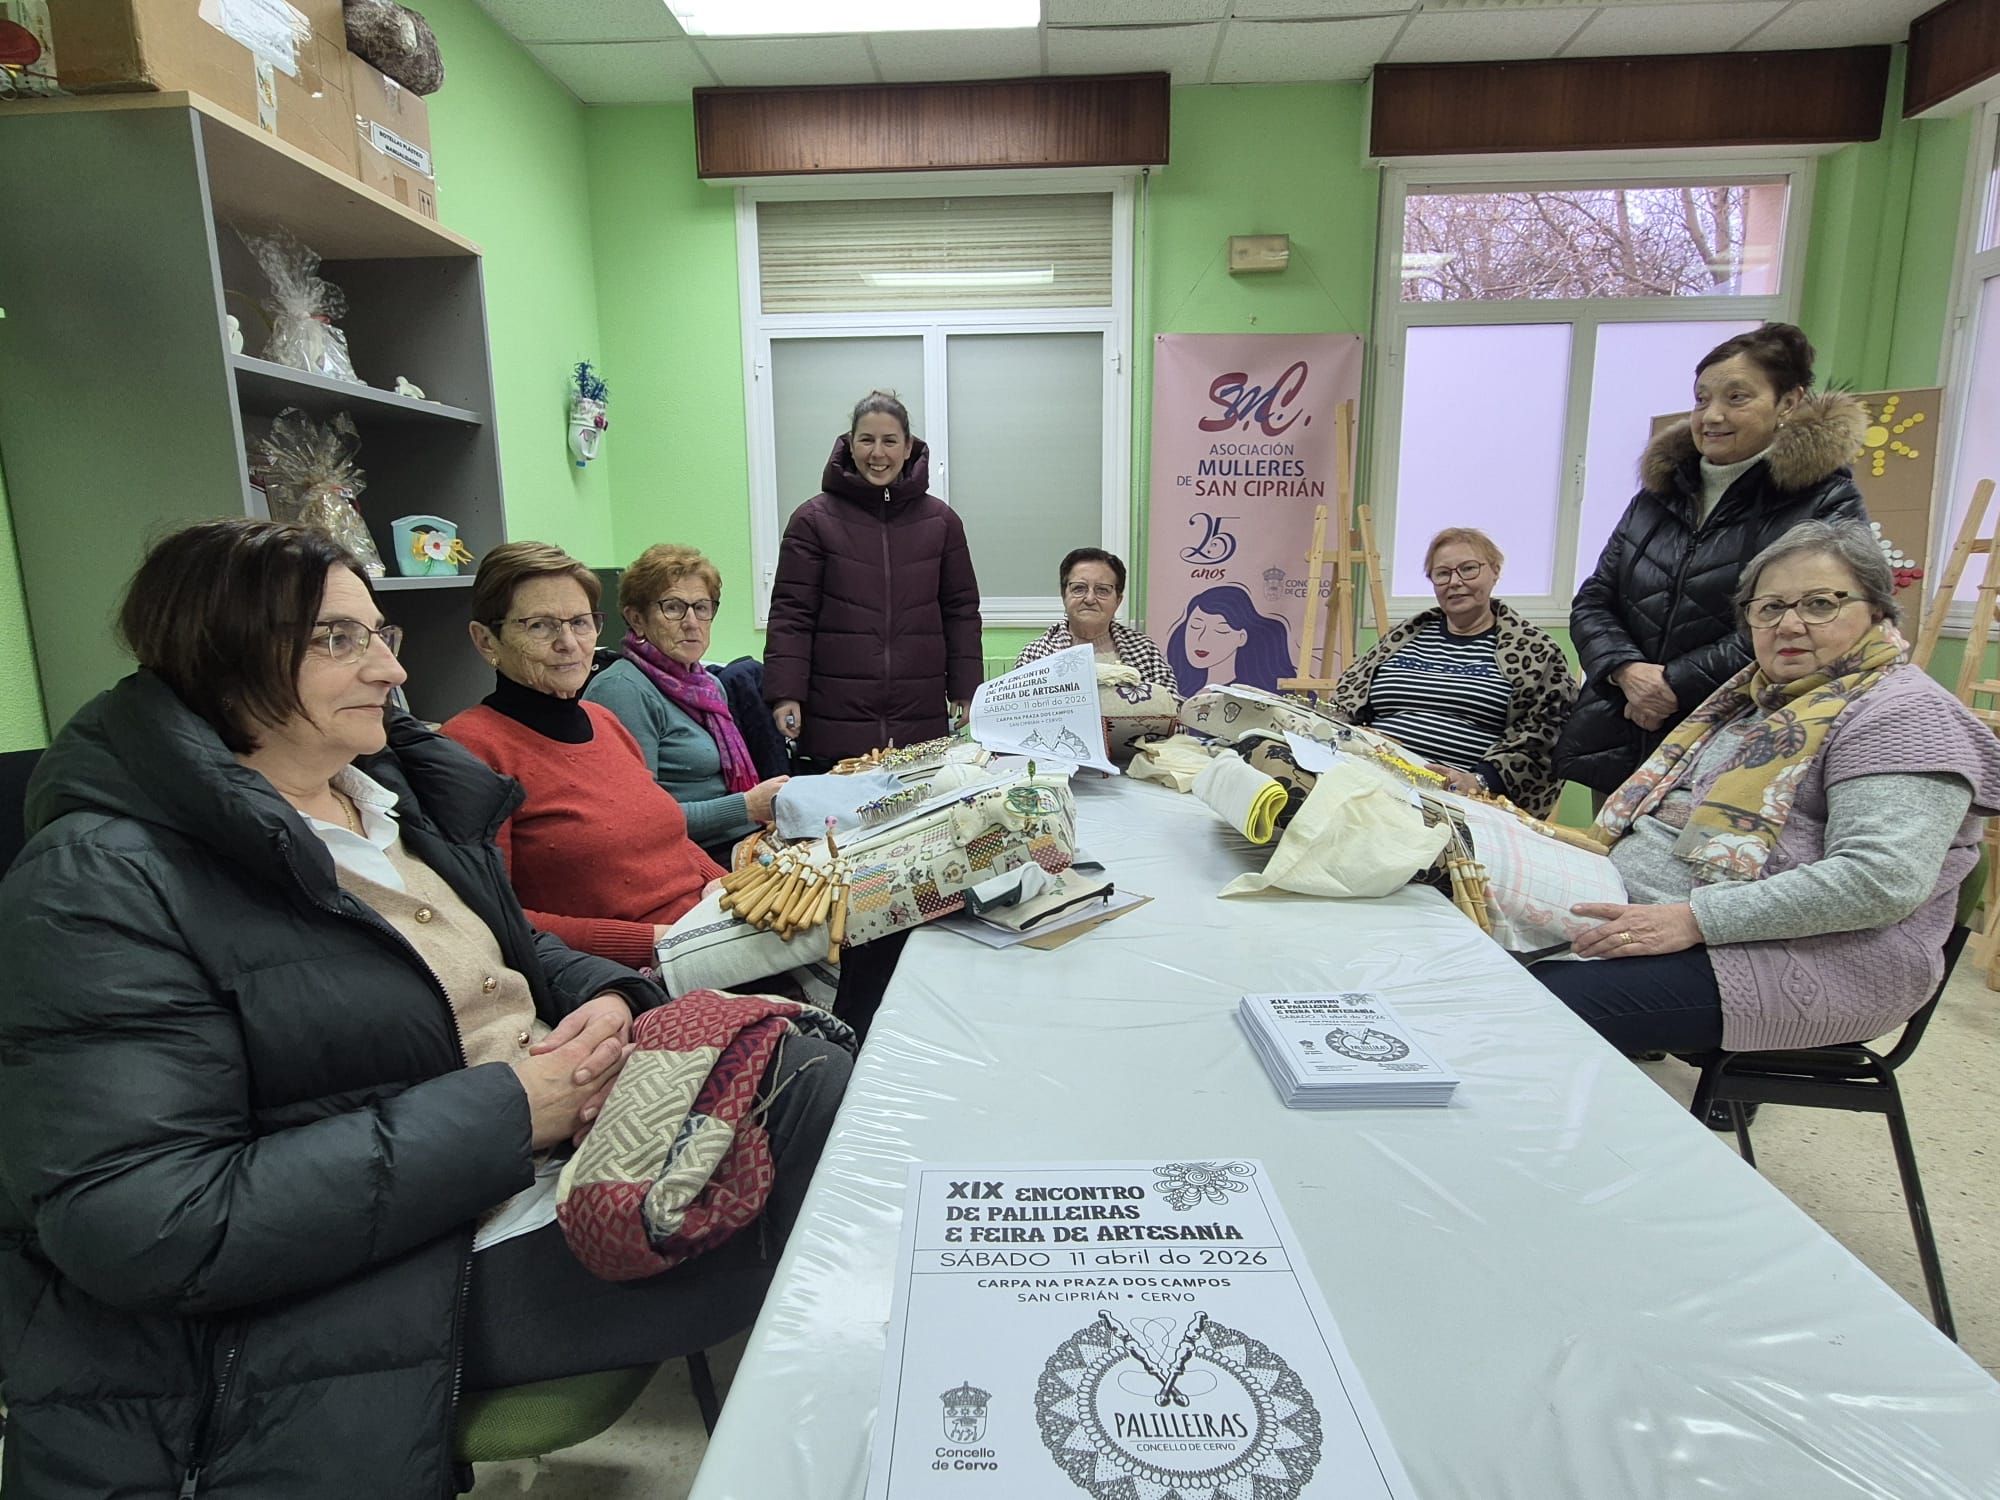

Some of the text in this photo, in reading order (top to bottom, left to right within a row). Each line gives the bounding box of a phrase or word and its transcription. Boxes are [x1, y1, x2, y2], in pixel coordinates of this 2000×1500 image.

[379, 130, 403, 148] BOTELLAS
[1209, 442, 1294, 456] ASOCIACIÓN
[1198, 460, 1305, 477] MULLERES
[1177, 476, 1325, 497] DE SAN CIPRIÁN
[1180, 512, 1241, 565] 25
[1190, 567, 1226, 581] anos
[988, 667, 1050, 690] XIX ENCONTRO
[998, 677, 1048, 694] PALILLEIRAS
[993, 692, 1016, 703] FEIRA
[1018, 689, 1031, 698] DE
[1033, 682, 1080, 696] ARTESANÍA
[1032, 699, 1050, 708] abril
[1052, 698, 1063, 706] do
[1065, 695, 1087, 704] 2026
[1052, 709, 1074, 717] CAMPOS
[946, 1181, 1145, 1201] XIX ENCONTRO
[946, 1205, 1140, 1221] DE PALILLEIRAS
[945, 1222, 1244, 1243] E FEIRA DE ARTESANÍA
[940, 1249, 1268, 1267] SÁBADO 11 abril do 2026
[977, 1277, 1231, 1288] CARPA NA PRAZA DOS CAMPOS
[1017, 1289, 1195, 1302] SAN CIPRIÁN CERVO
[1114, 1412, 1249, 1438] PALILLEIRAS
[935, 1447, 996, 1458] Concello
[1136, 1443, 1236, 1452] CONCELLO DE CERVO
[931, 1459, 998, 1471] de Cervo
